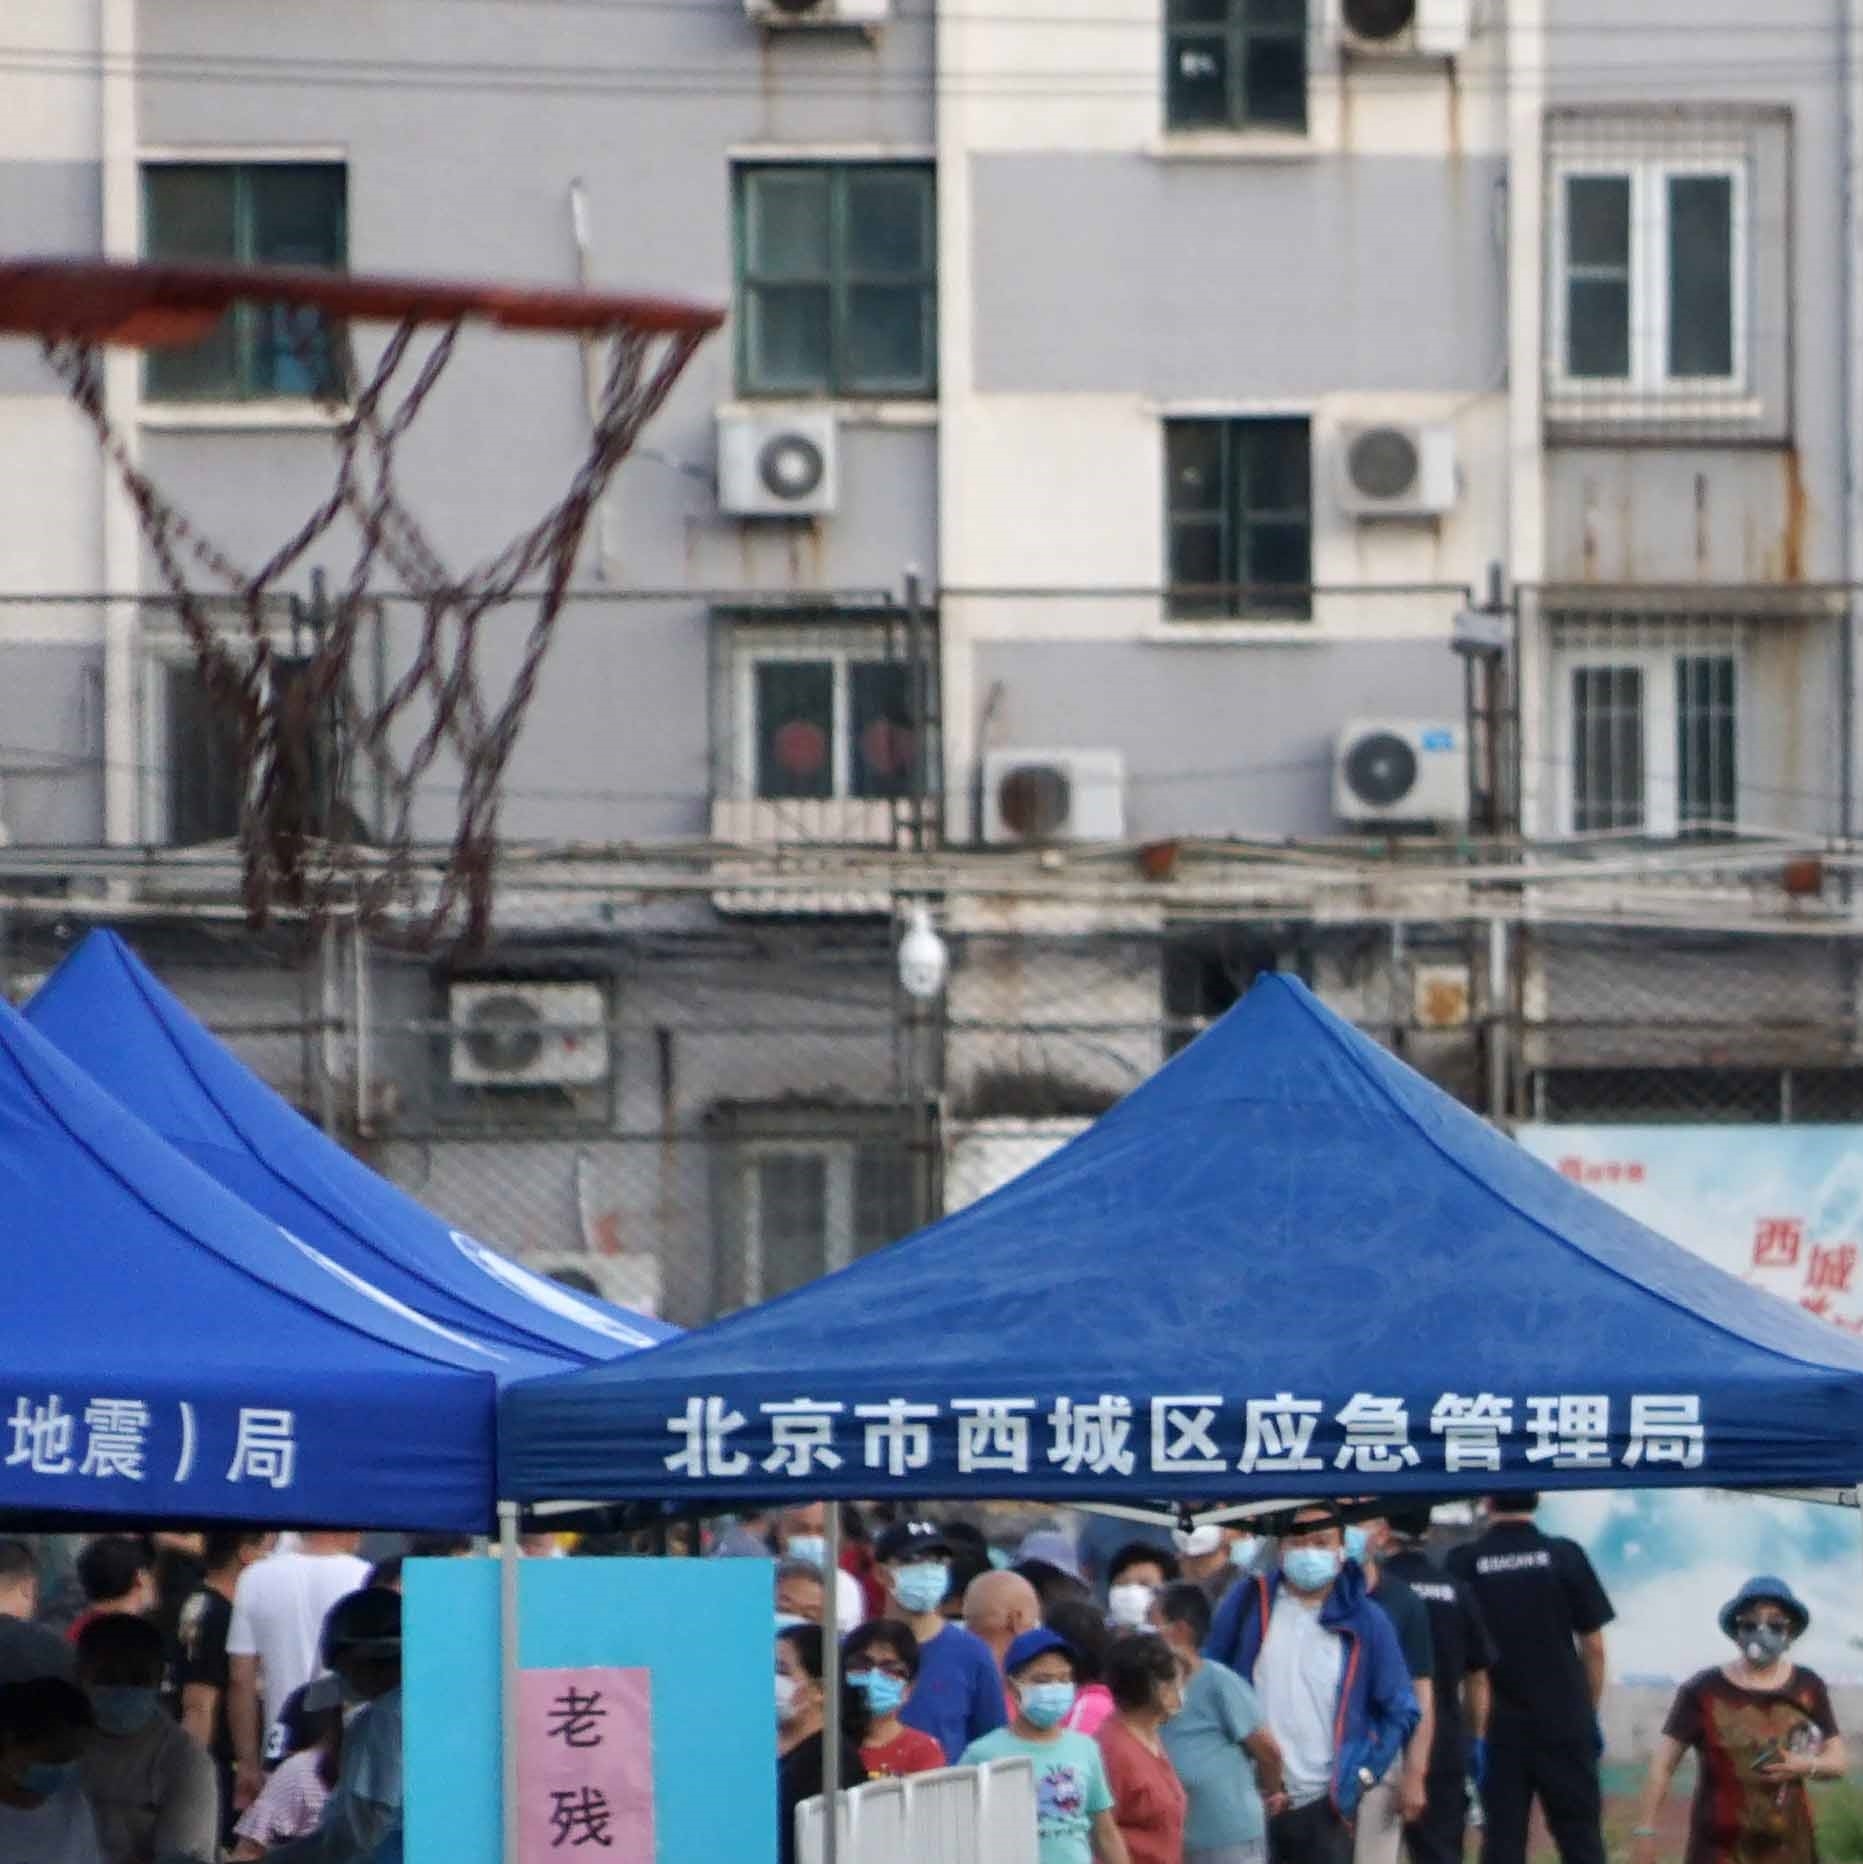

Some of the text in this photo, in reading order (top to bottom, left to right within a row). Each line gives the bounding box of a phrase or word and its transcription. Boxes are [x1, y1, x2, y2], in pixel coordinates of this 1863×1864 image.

[1752, 1217, 1857, 1292] 西城
[664, 1393, 1706, 1478] 北京市西城区应急管理局
